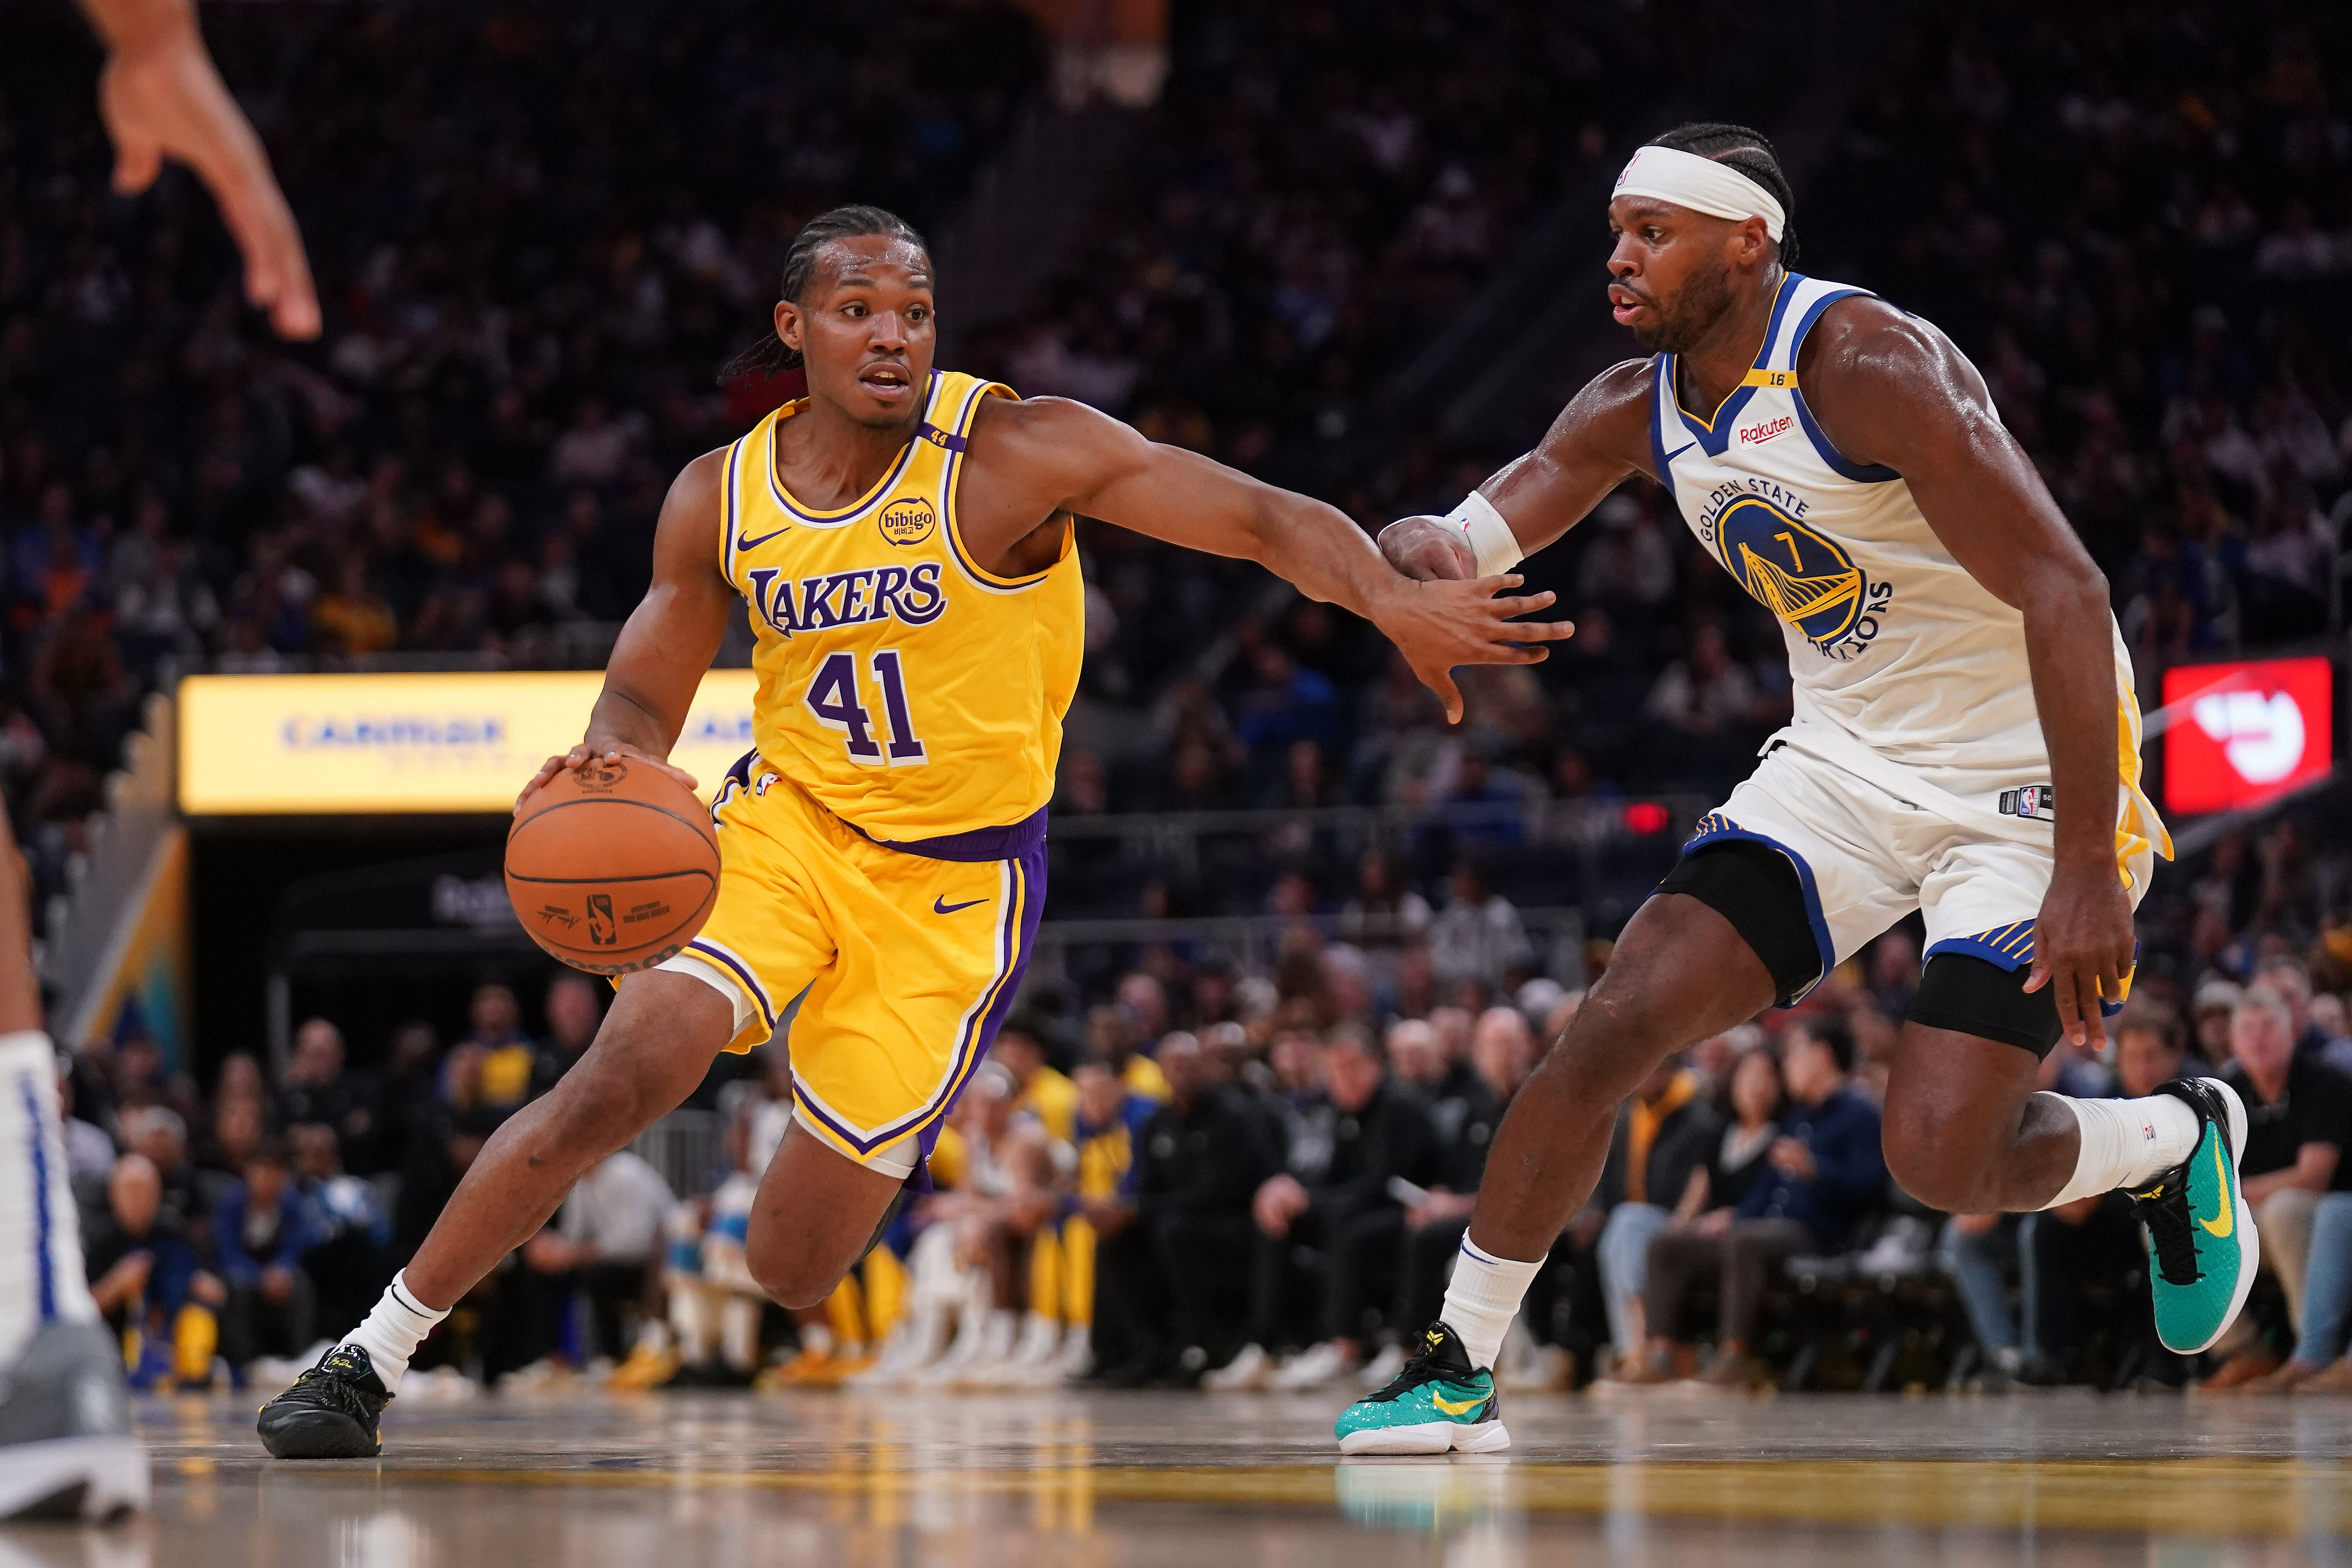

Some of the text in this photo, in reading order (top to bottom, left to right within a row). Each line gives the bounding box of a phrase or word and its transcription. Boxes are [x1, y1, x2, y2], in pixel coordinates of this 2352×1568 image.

[1770, 373, 1785, 386] 16
[931, 429, 948, 446] 44
[1740, 416, 1794, 444] Rakuten
[885, 510, 933, 530] bibigo
[1700, 478, 1809, 542] GOLDEN STATE
[894, 526, 914, 535] 비비고
[1774, 531, 1804, 573] 7
[747, 561, 949, 641] LAKERS
[803, 648, 930, 768] 41
